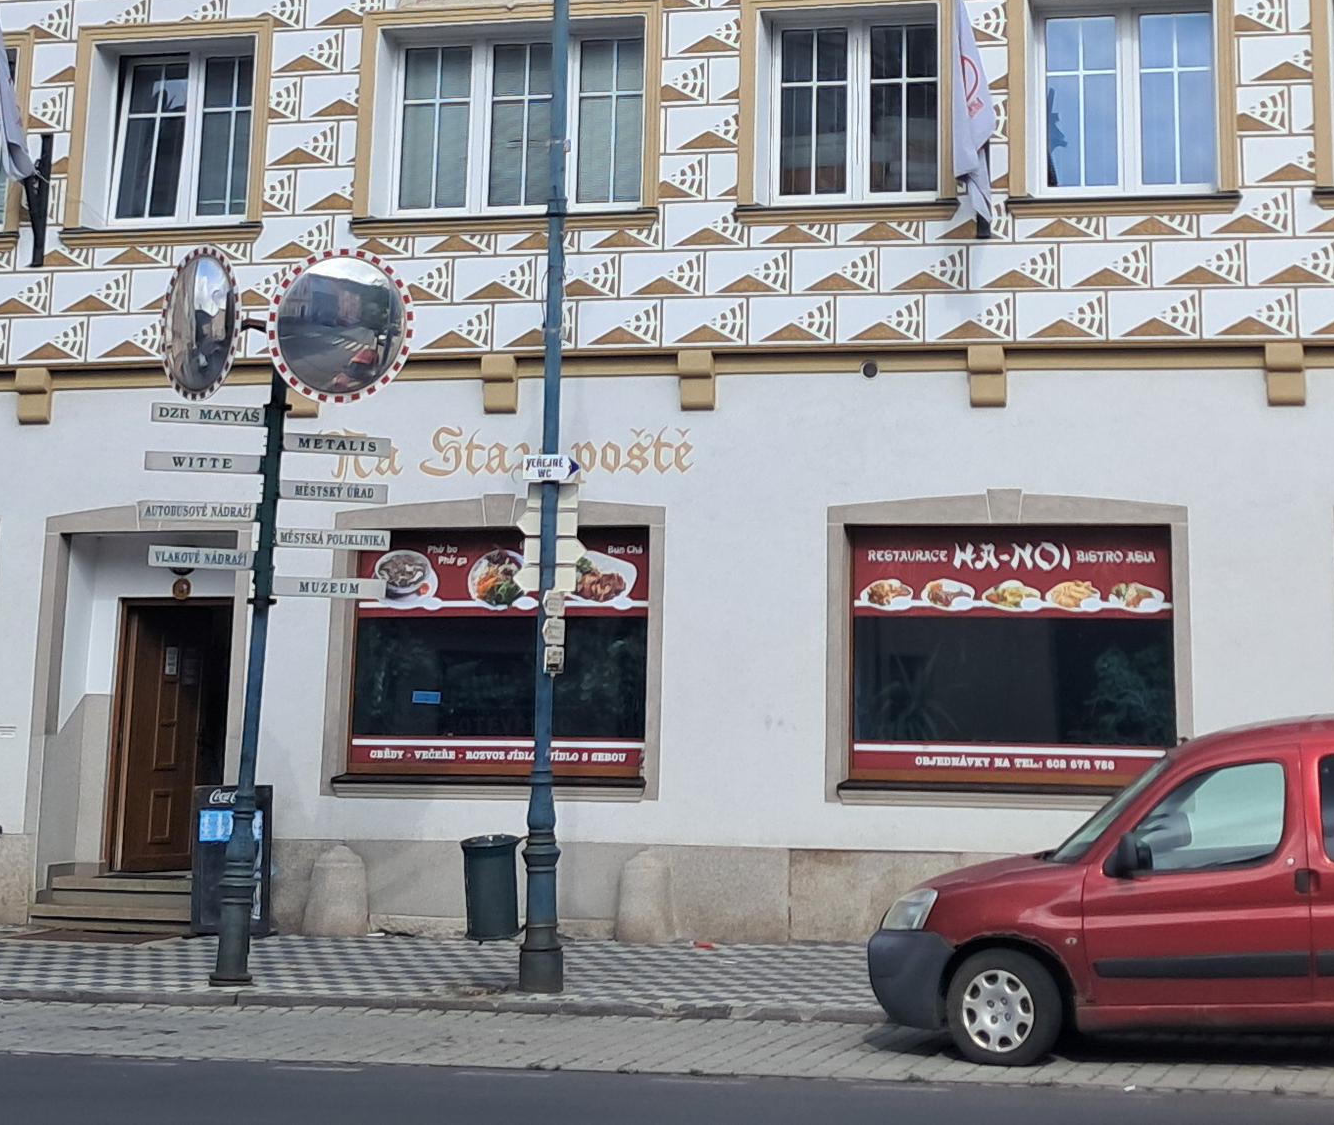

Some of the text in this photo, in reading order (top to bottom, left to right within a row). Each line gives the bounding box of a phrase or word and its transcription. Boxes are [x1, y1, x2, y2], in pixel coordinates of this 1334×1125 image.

[158, 406, 260, 423] DZR MATYÁŠ
[298, 437, 377, 452] METALIS
[172, 456, 232, 469] WITTE
[537, 469, 552, 478] WC
[295, 482, 374, 499] MĚSTSKÝ ÚŘAD
[144, 503, 252, 518] AUTOBUSOVÉ NÁDRAŽÍ
[280, 529, 386, 547] MĚSTSKÁ POLIKLINIKA
[154, 550, 248, 566] VLAKOVÉ NÁDRAŽÍ
[867, 541, 1156, 571] RESTAURACE HA-NOI BISTRO ASIA
[299, 581, 360, 594] MUZEUM
[915, 754, 991, 767] OBJEDNÁVKY
[994, 757, 1011, 768] NA
